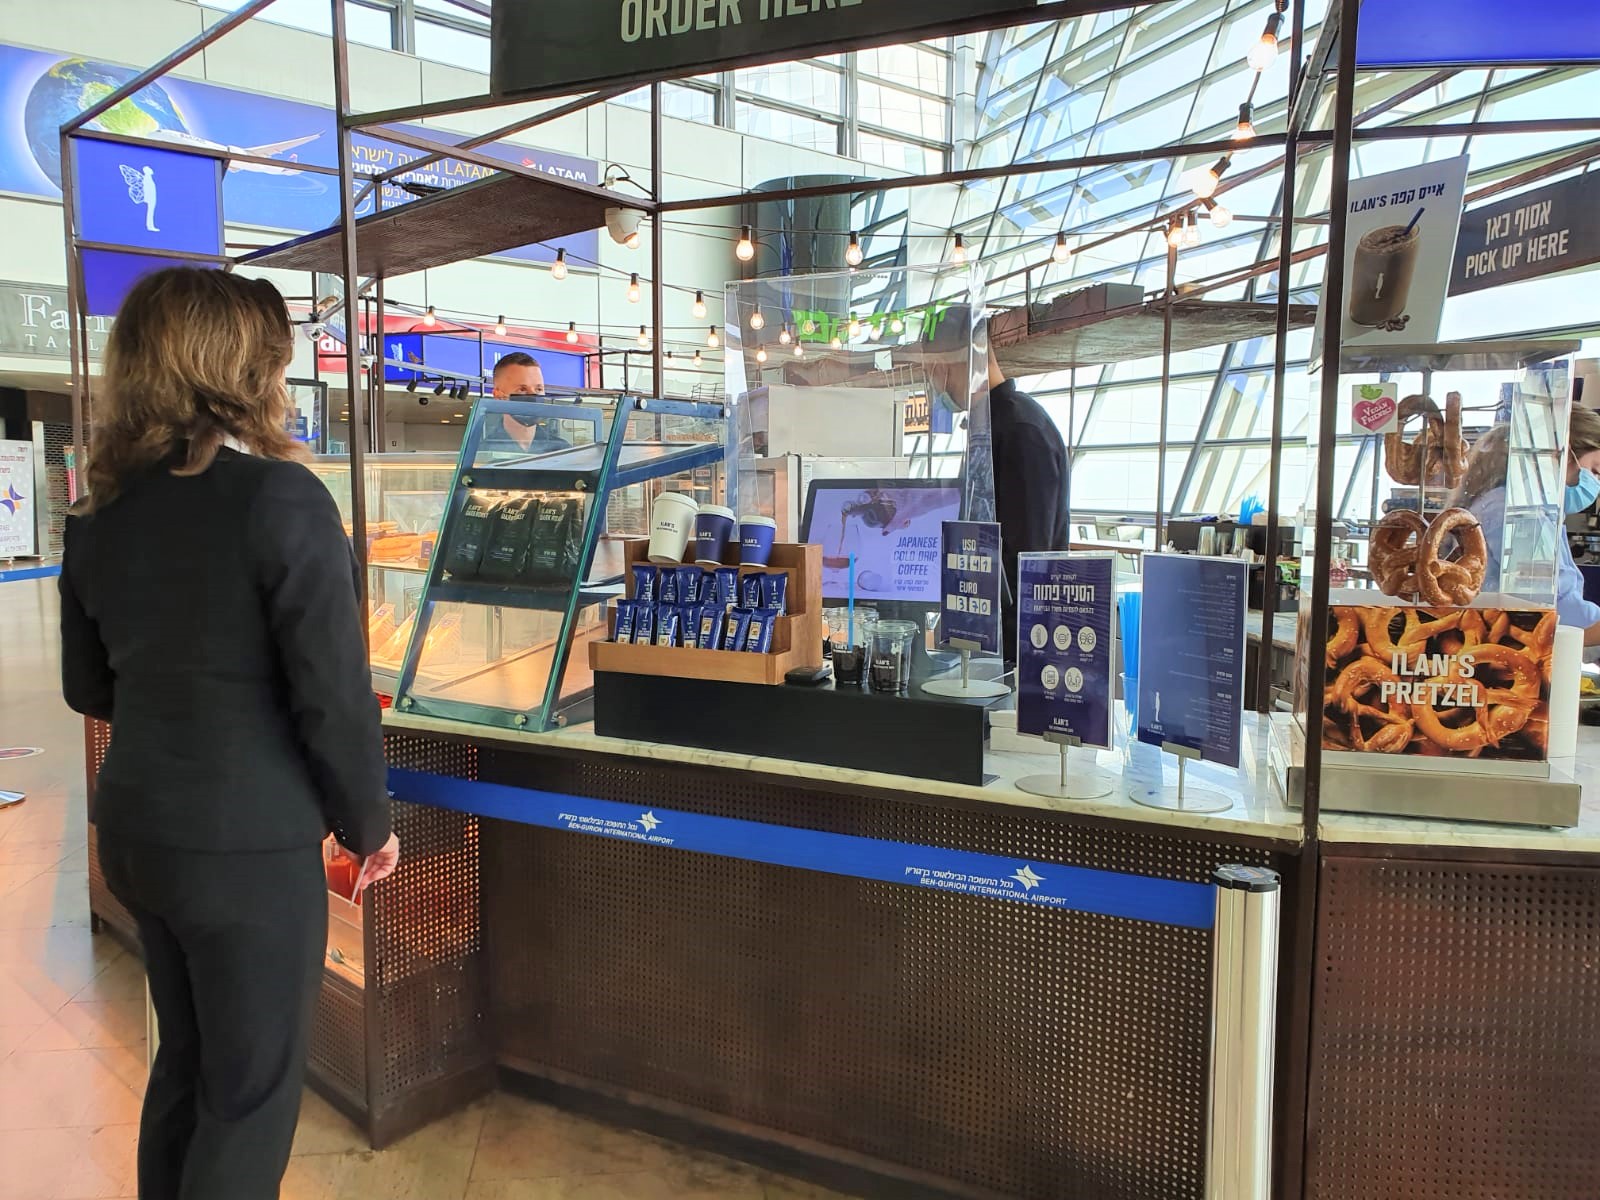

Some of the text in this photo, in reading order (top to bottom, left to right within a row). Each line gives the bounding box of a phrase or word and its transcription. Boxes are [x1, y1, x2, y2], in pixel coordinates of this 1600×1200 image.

[621, 0, 742, 42] ORDER
[352, 145, 394, 165] לישרא
[1350, 195, 1388, 213] ILAN'S
[1390, 189, 1416, 205] קפה
[1485, 199, 1552, 246] אסוף כאן
[1465, 229, 1569, 279] PICK UP HERE
[896, 537, 939, 548] JAPANESE
[962, 538, 976, 551] USD
[893, 550, 938, 562] COLD DRIP
[897, 564, 929, 576] COFFEE
[959, 581, 978, 595] EURO
[1033, 584, 1095, 604] הסניף פתוח
[1391, 652, 1475, 678] ILAN'S
[1380, 681, 1485, 707] PRETZEL
[604, 827, 648, 840] INTERNATIONAL
[648, 835, 674, 845] AIRPORT
[968, 875, 998, 886] התעופה
[1000, 878, 1014, 889] נמל
[920, 877, 1068, 905] BEN-GURION INTERNATIONAL AIRPORT
